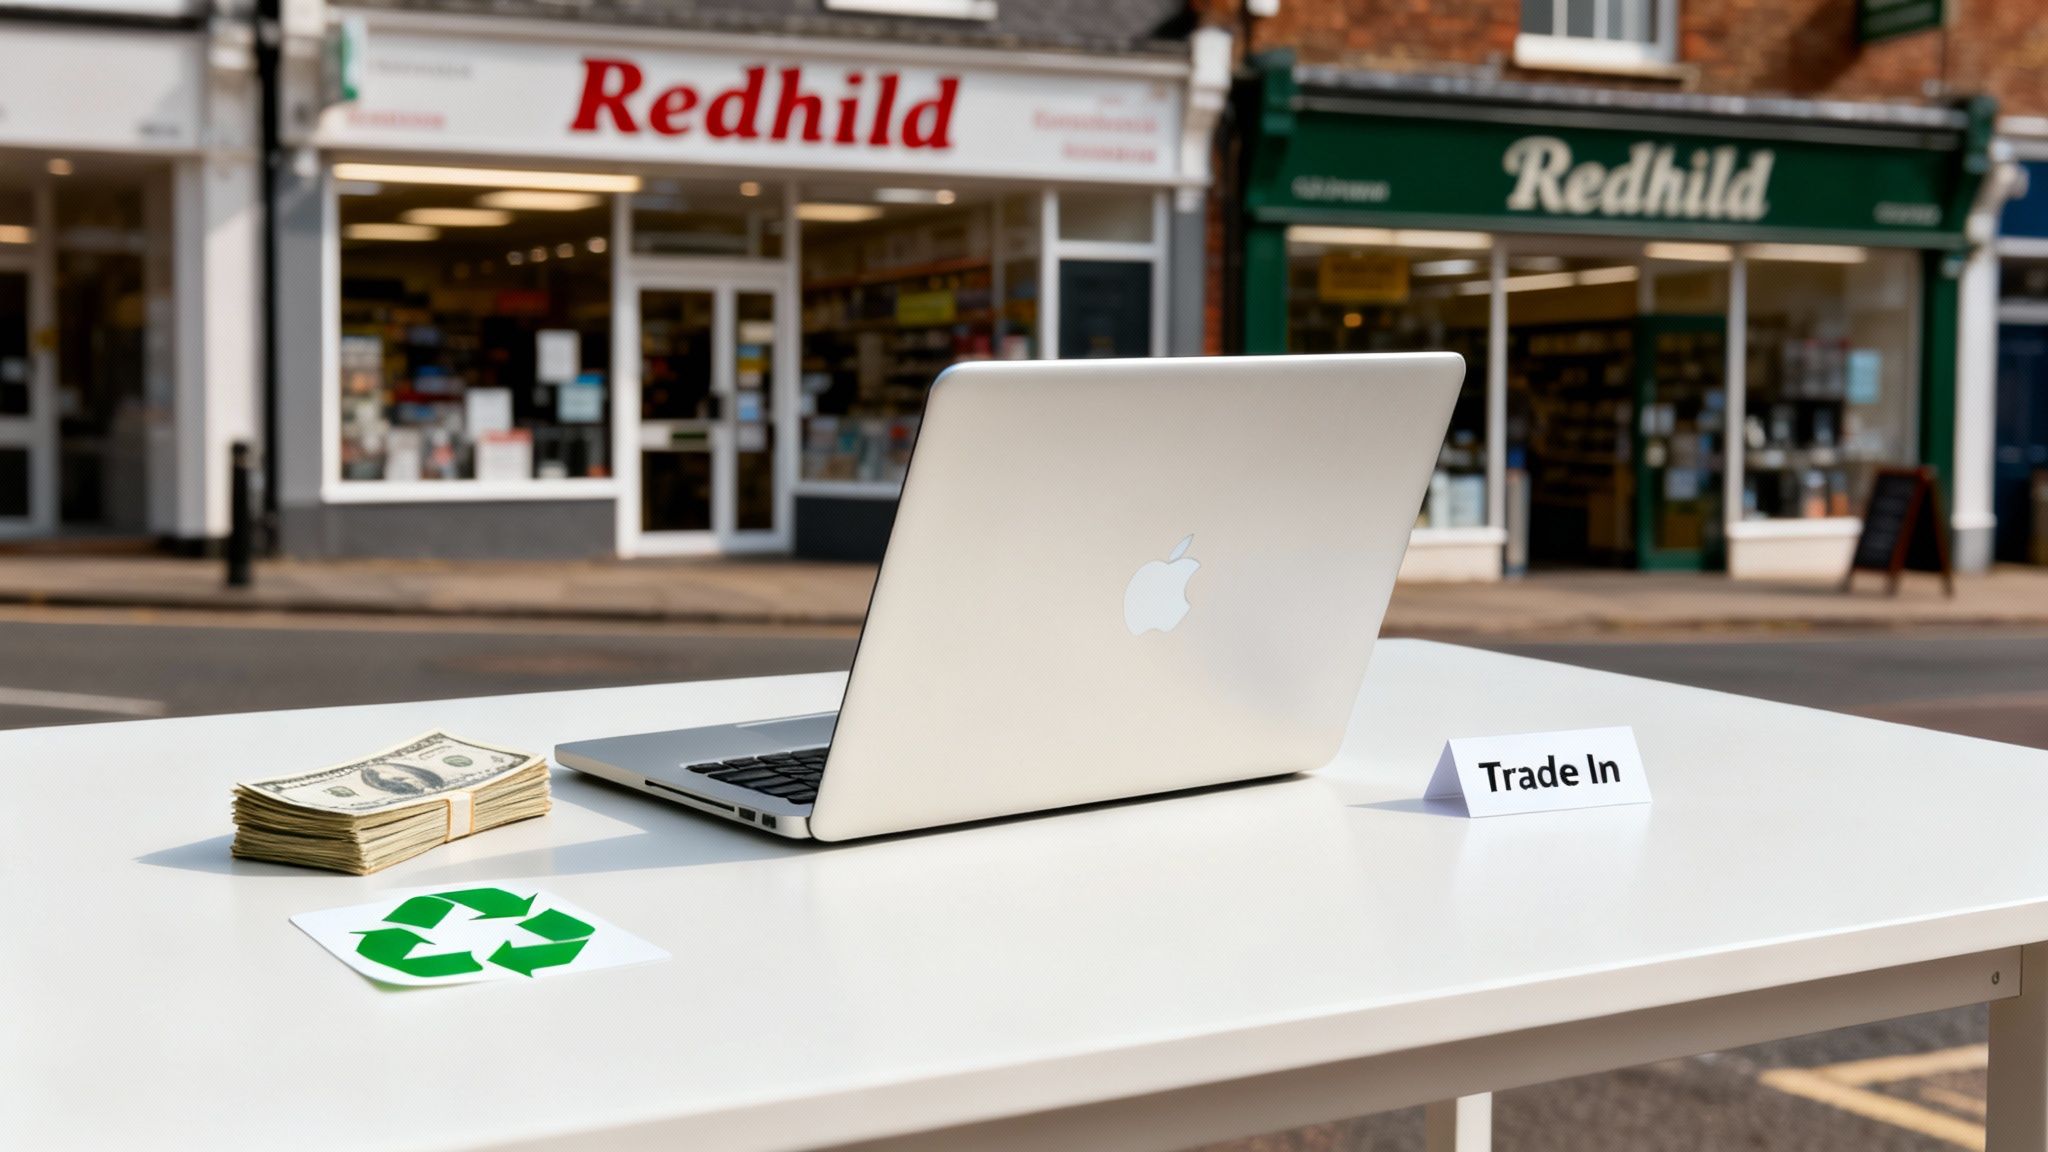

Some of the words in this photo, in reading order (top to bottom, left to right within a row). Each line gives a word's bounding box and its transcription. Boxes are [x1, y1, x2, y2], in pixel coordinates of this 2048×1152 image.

[569, 56, 960, 150] Redhild
[1502, 135, 1774, 222] Redhild
[1478, 755, 1579, 792] Trade
[1586, 754, 1621, 784] In
